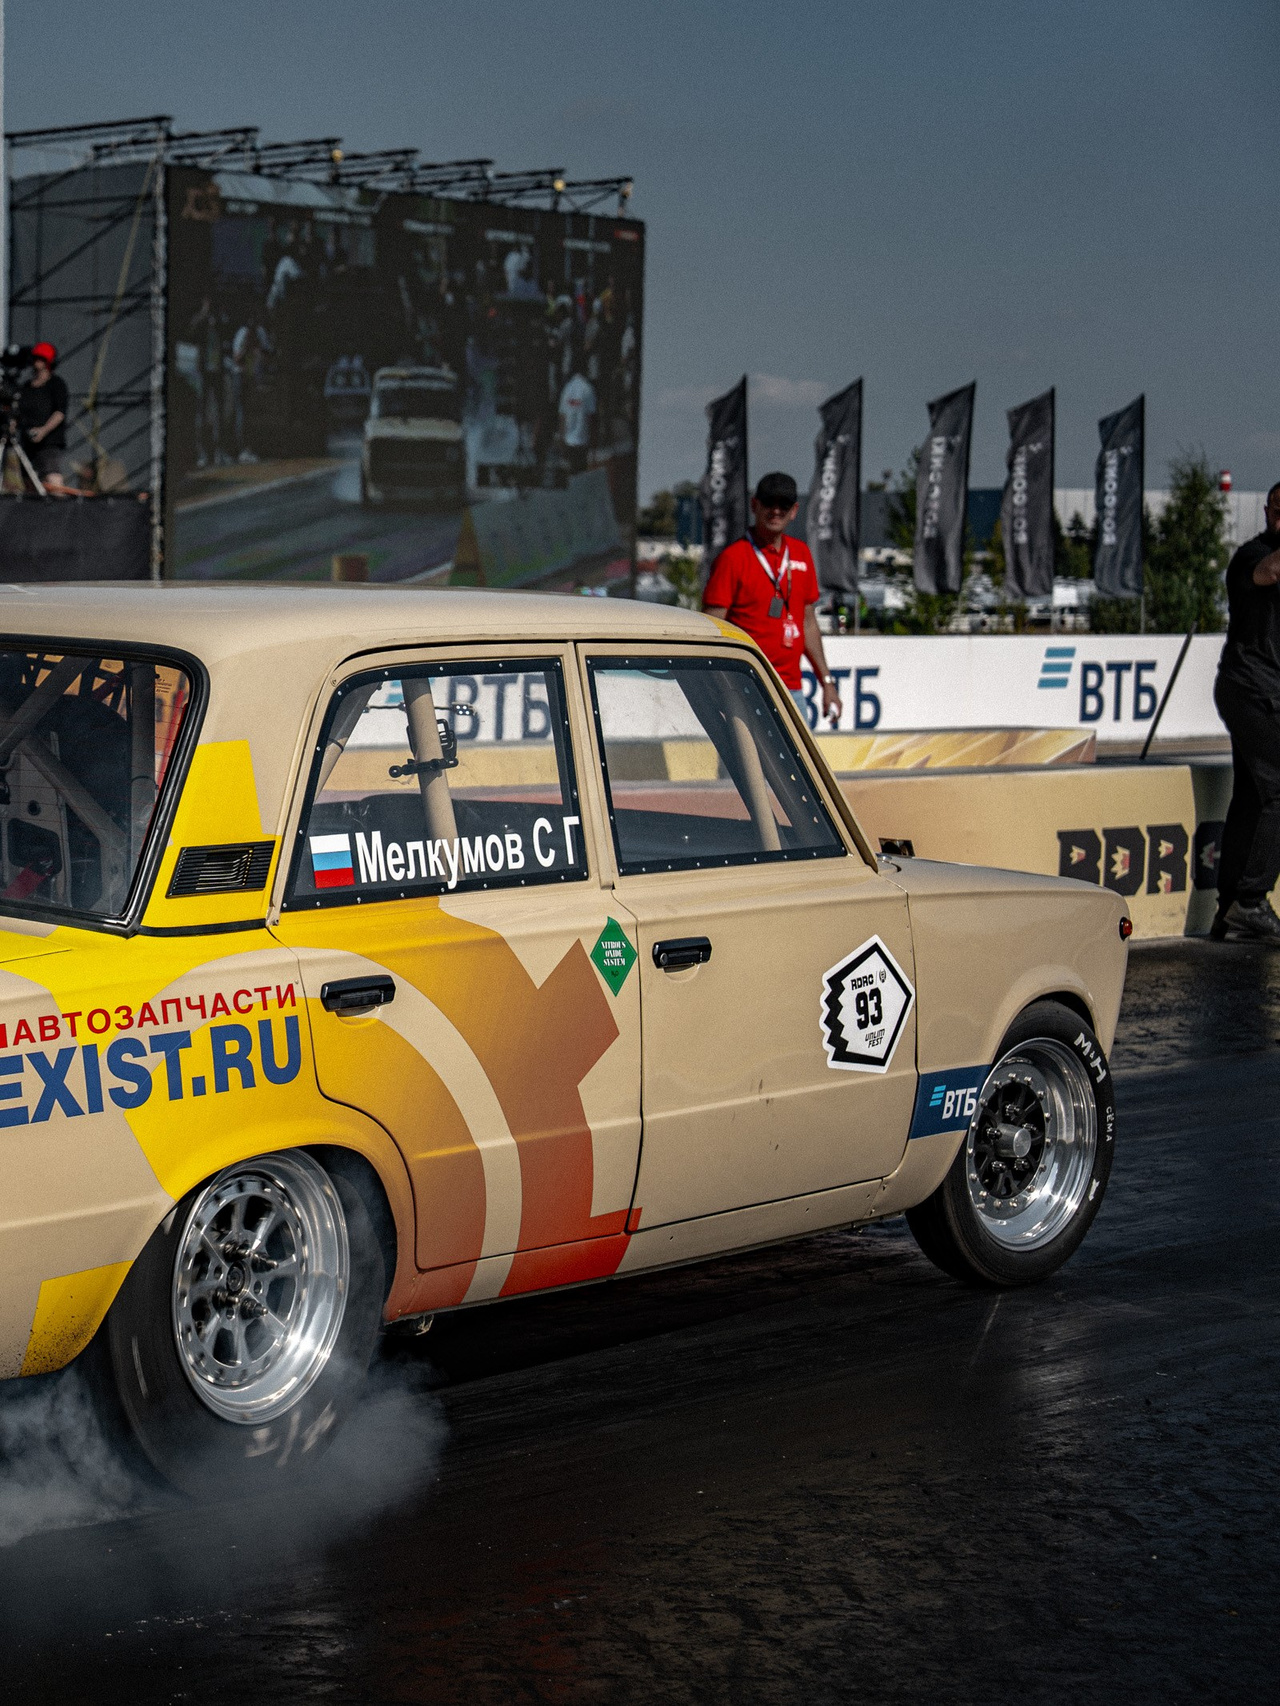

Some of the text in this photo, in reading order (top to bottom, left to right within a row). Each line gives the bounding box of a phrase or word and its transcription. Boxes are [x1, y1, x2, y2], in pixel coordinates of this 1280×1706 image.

[449, 673, 552, 740] ВТБ
[1079, 661, 1158, 722] ВТБ
[354, 815, 579, 889] Мелкумов С Г
[600, 940, 626, 949] NITROUS
[605, 950, 622, 958] OXIDE
[603, 958, 626, 967] SYSTEM
[850, 973, 874, 991] RDRC
[11, 982, 298, 1047] АВТОЗАПЧАСТИ
[855, 987, 883, 1030] 93
[867, 1037, 884, 1048] FEST
[941, 1087, 978, 1120] ВТБ
